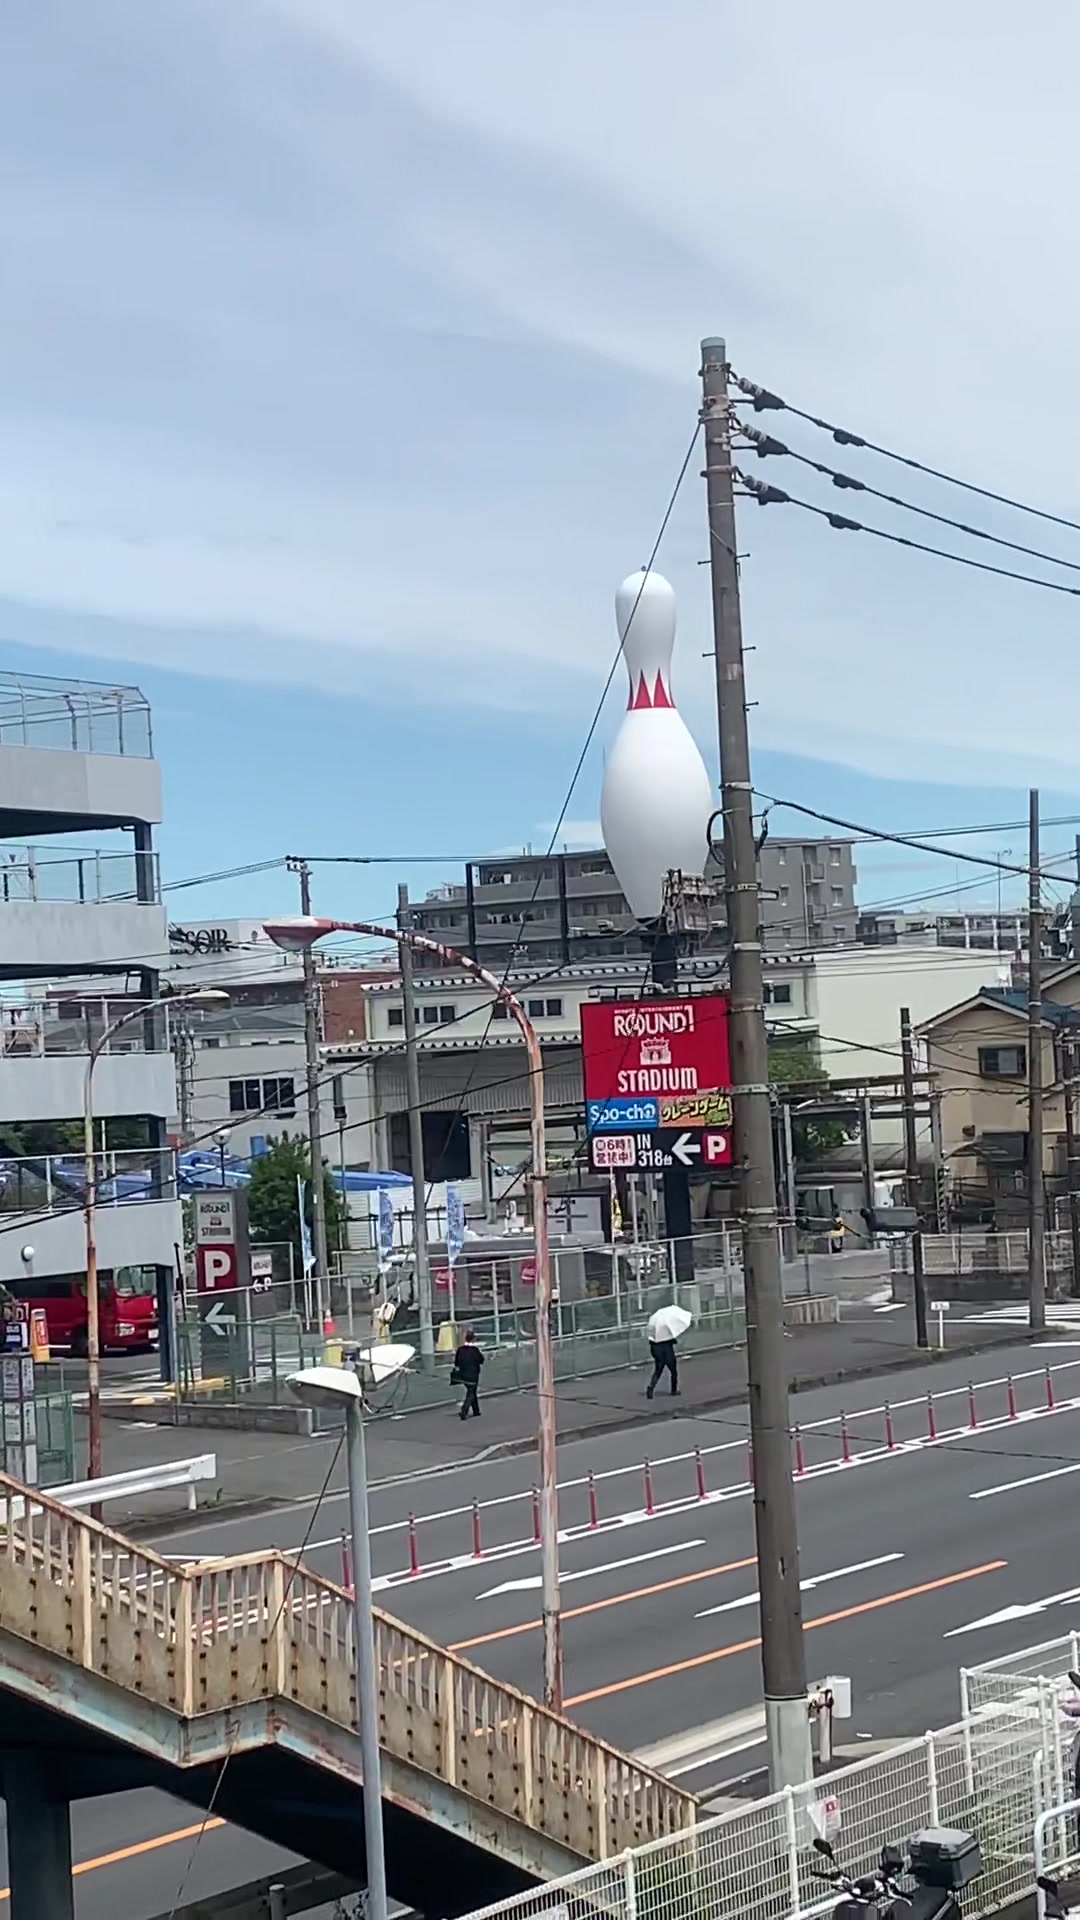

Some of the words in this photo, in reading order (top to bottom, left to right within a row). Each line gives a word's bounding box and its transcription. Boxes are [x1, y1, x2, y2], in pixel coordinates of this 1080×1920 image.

[617, 1067, 698, 1093] STADIUM
[595, 1138, 632, 1152] 6時!
[637, 1134, 651, 1150] IN
[707, 1135, 726, 1160] P
[204, 1251, 231, 1288] P
